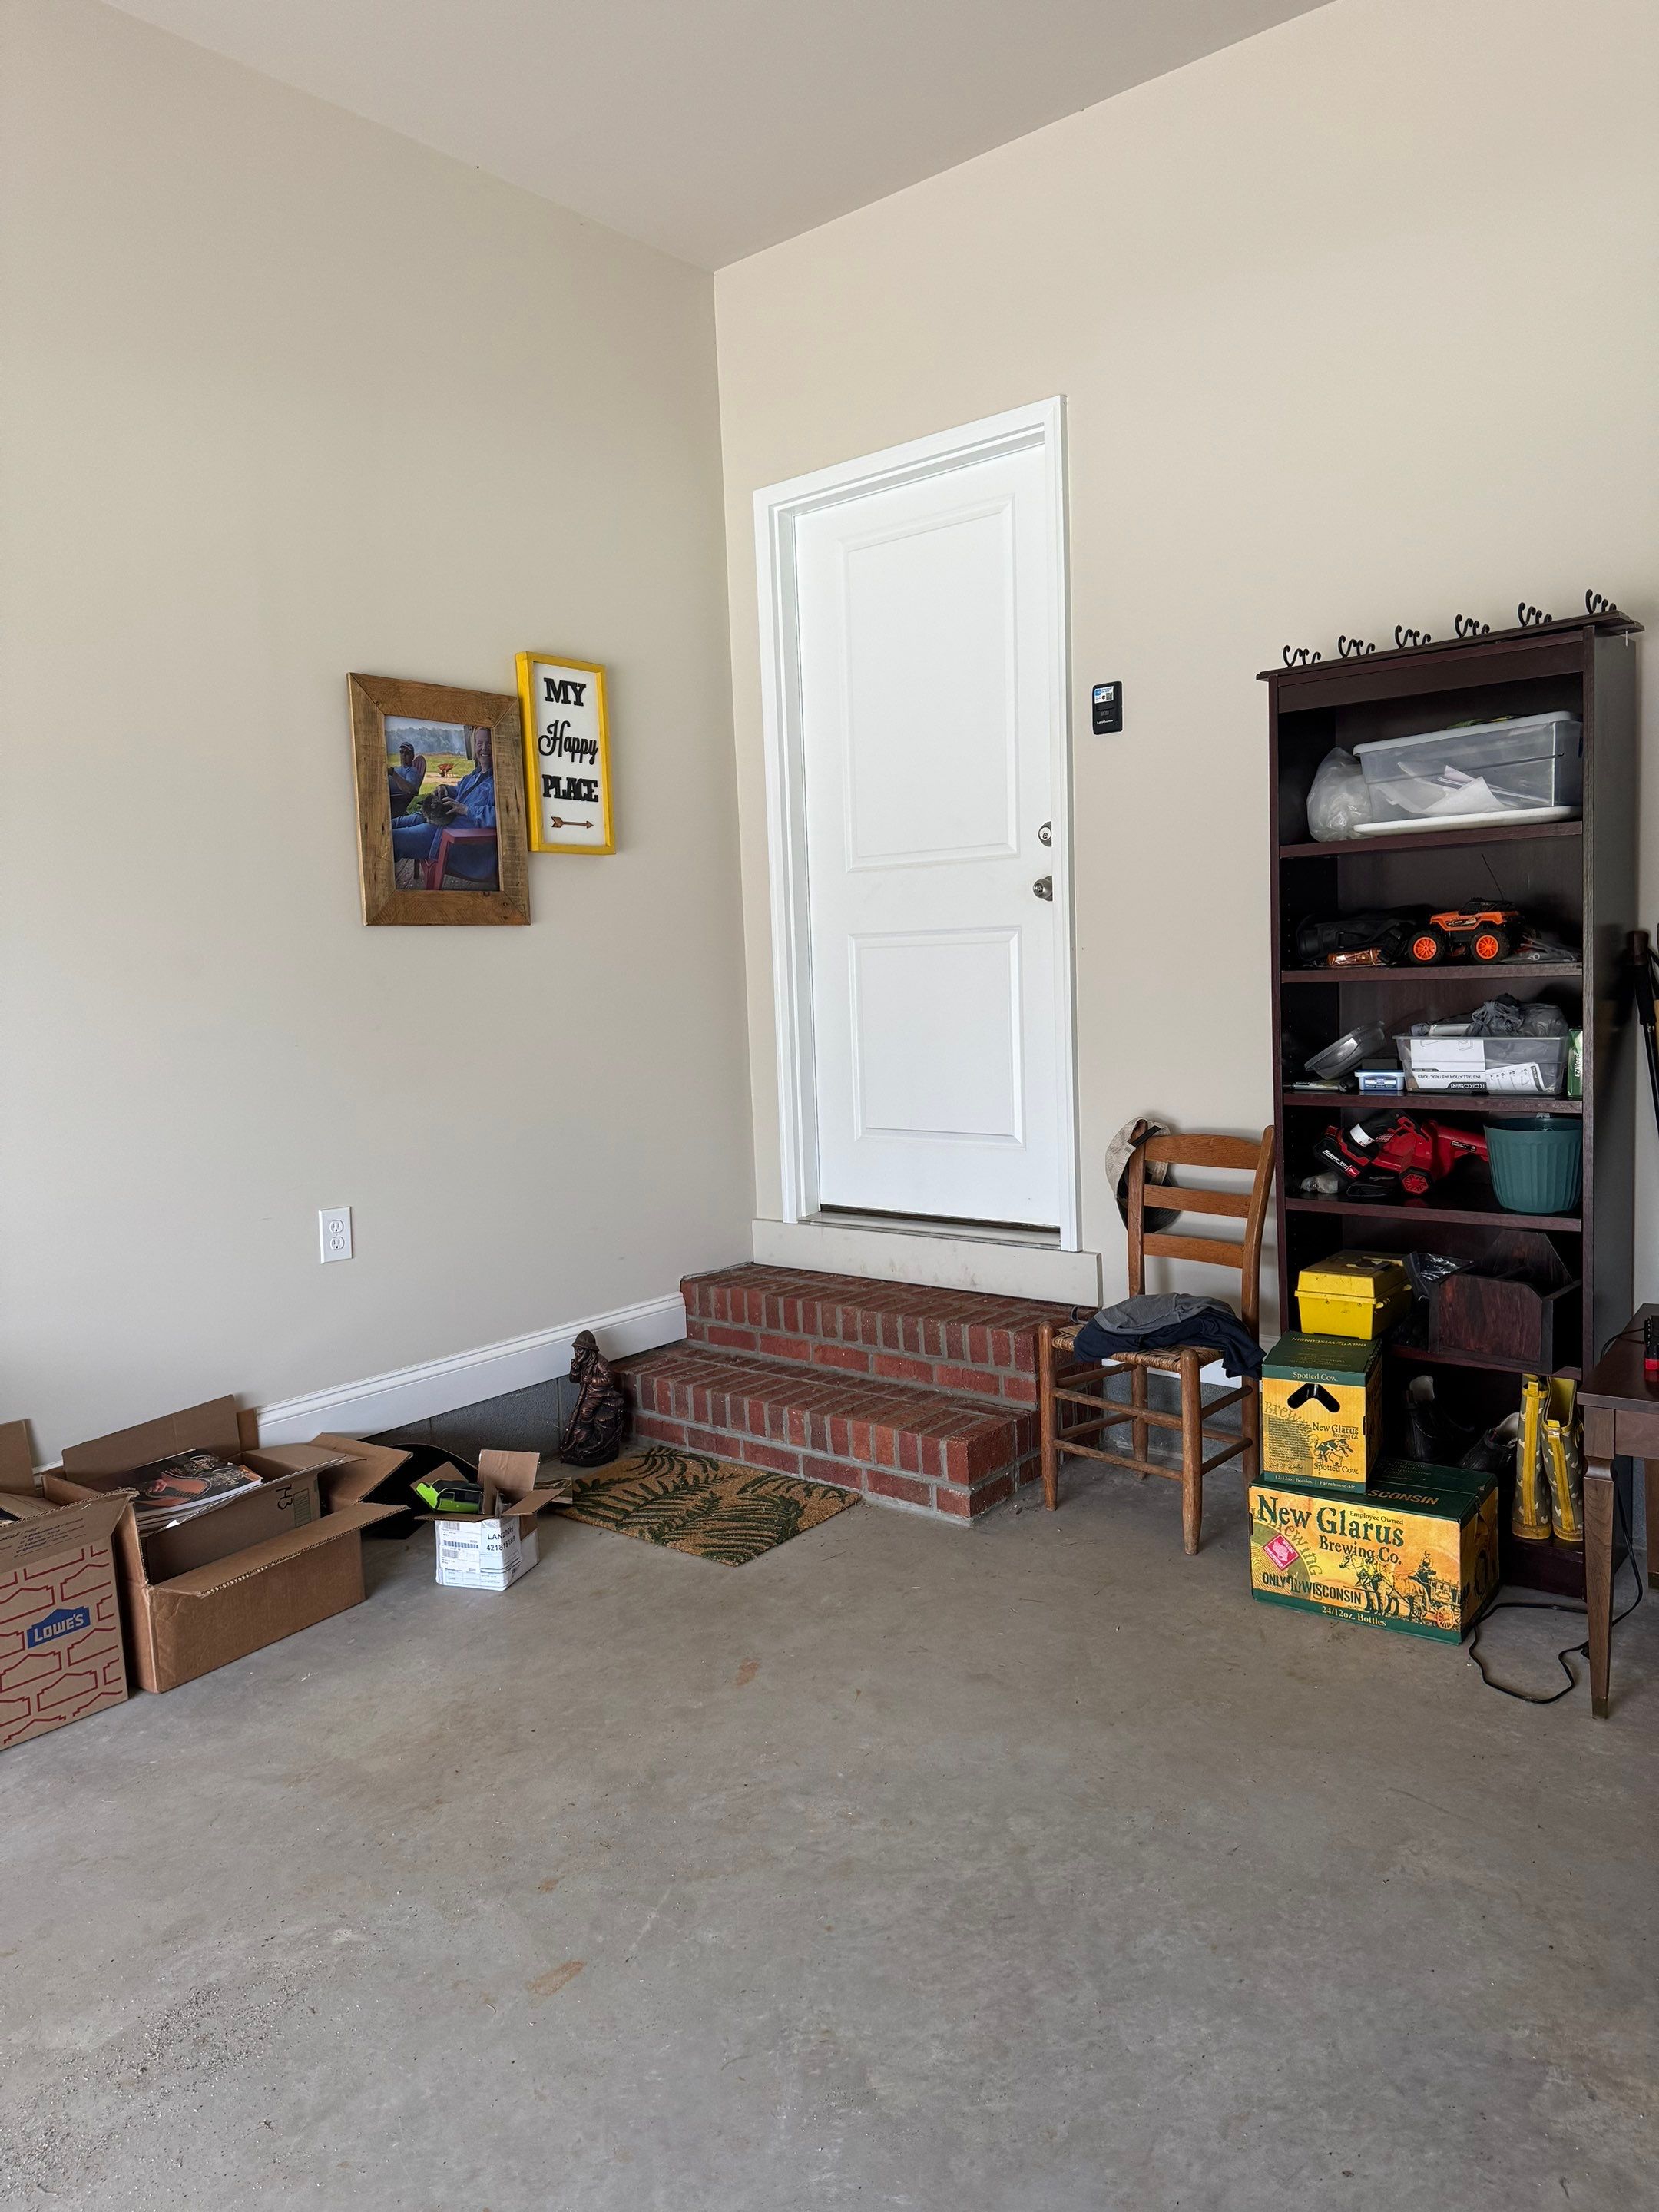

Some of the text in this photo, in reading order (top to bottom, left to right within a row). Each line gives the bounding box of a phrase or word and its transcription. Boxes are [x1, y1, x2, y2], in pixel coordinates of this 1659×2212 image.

[543, 677, 587, 707] MY
[538, 719, 598, 765] Happy
[542, 774, 599, 803] PLACE
[1293, 1371, 1320, 1381] Spotted
[1313, 1422, 1359, 1435] New Glarus
[1314, 1462, 1341, 1472] Spotted
[1368, 1489, 1439, 1505] SCONSIN
[1257, 1494, 1405, 1547] New Glarus
[1349, 1511, 1403, 1525] Employee Owned
[1319, 1535, 1375, 1561] Brewing
[1378, 1546, 1402, 1565] Co.
[1262, 1572, 1287, 1588] ONLY
[1302, 1581, 1362, 1604] WISCONSIN
[34, 1613, 84, 1642] LOWE'S
[1322, 1605, 1386, 1627] 24/12oz. Bottles
